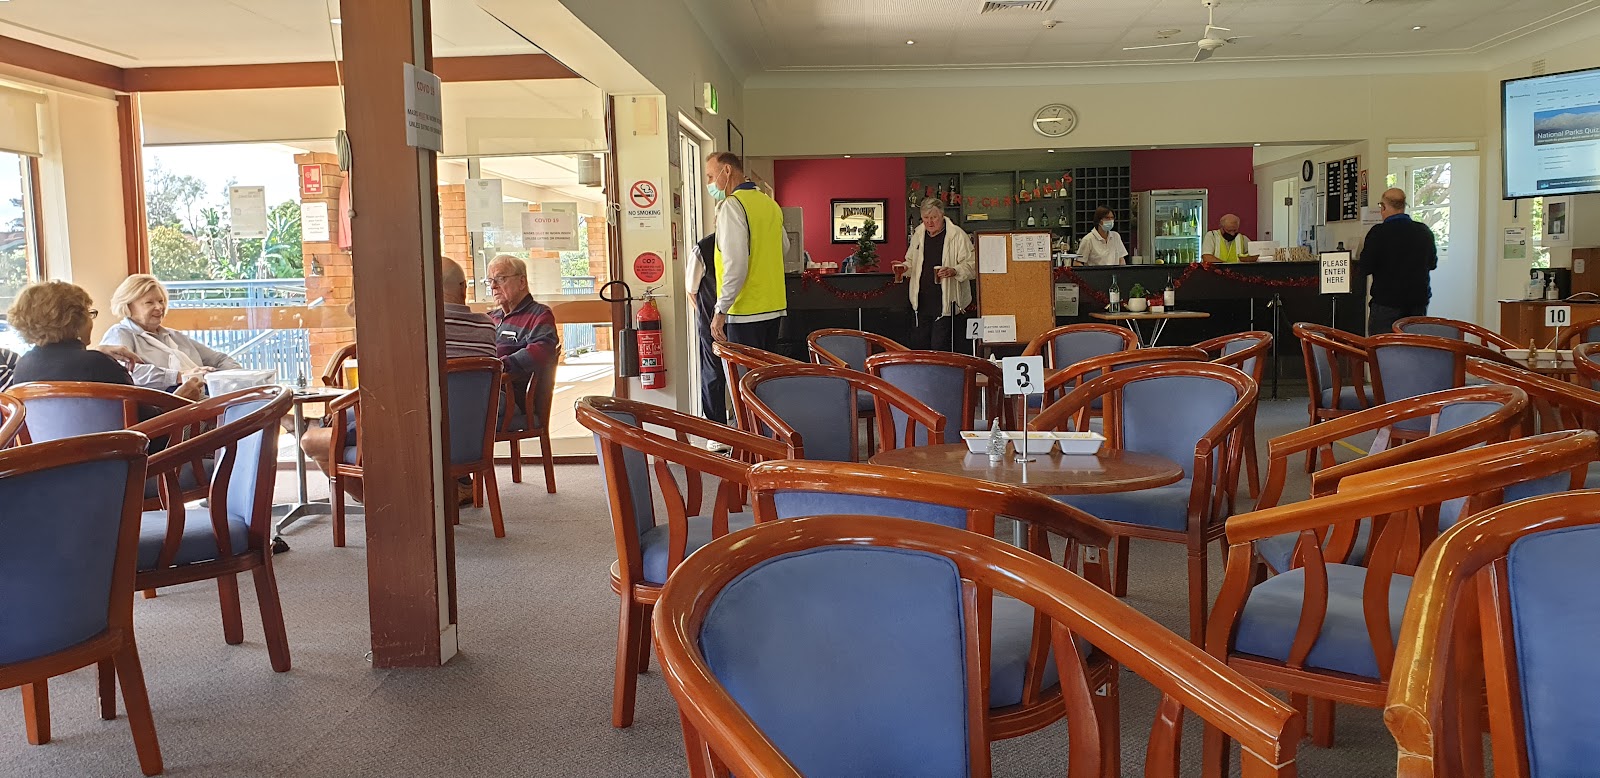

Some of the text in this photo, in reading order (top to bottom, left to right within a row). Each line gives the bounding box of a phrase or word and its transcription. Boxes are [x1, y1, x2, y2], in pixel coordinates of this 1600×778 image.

[416, 81, 430, 94] COVID
[1537, 131, 1564, 139] National
[911, 173, 1073, 208] MERRY CHRISTMAS
[1322, 259, 1348, 267] PLEASE
[1324, 268, 1346, 276] ENTER
[1550, 309, 1566, 323] 10
[972, 322, 979, 336] 2
[1016, 362, 1030, 388] 3
